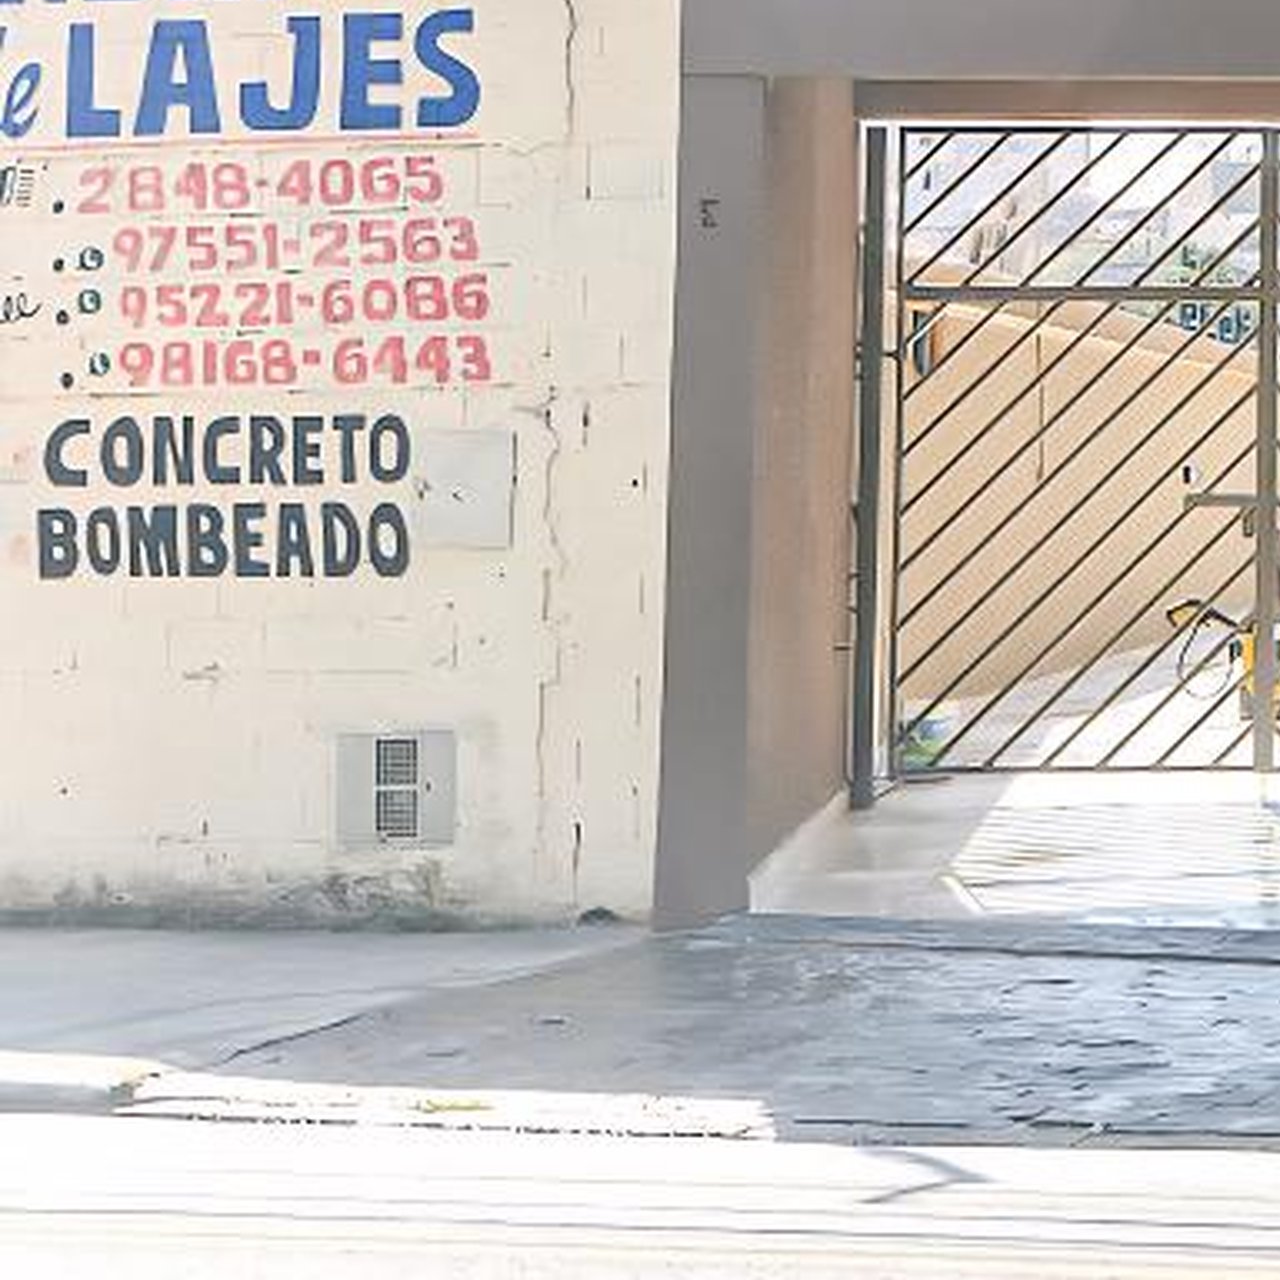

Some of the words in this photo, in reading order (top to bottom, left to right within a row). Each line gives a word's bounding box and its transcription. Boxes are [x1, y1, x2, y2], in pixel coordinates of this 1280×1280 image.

[65, 9, 481, 139] LAJES
[77, 156, 444, 215] 2848-4065
[113, 216, 480, 273] 97551-2563
[120, 273, 490, 328] 95221-6086
[119, 334, 492, 388] 98168-6443
[43, 414, 411, 487] CONCRETO
[37, 502, 411, 579] BOMBEADO
